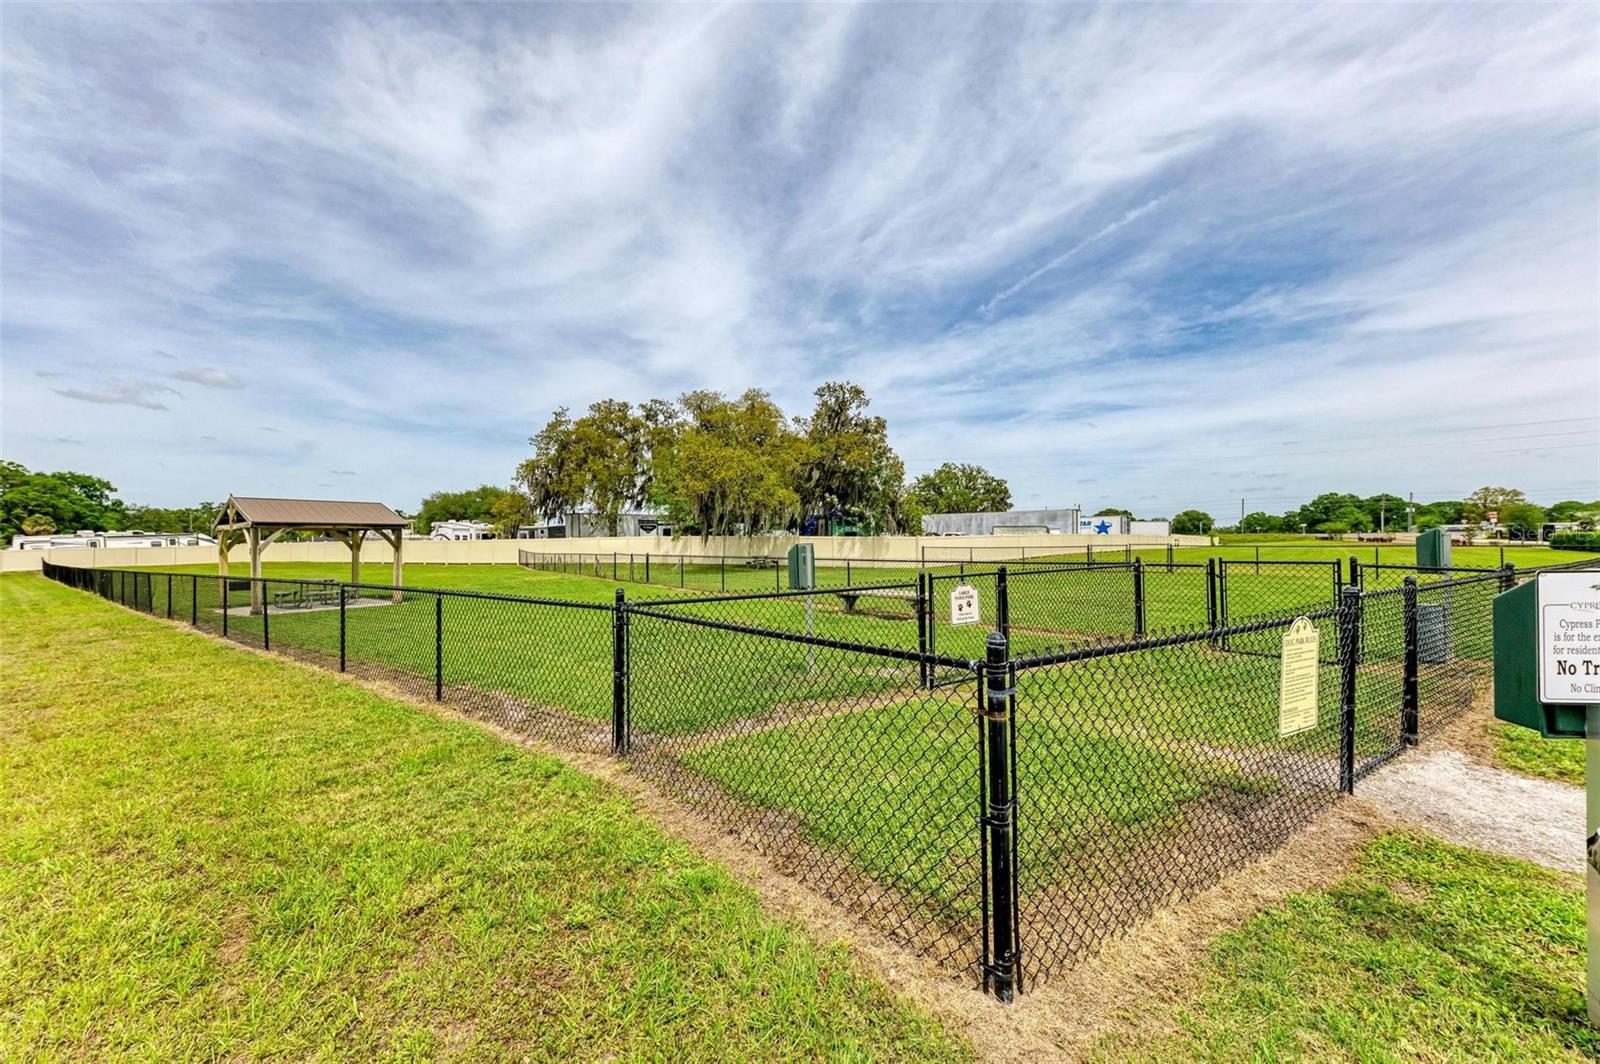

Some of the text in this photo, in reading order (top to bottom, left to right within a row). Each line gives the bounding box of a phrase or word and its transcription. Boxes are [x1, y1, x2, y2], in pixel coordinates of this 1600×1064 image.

[1559, 619, 1593, 631] Cypress
[1553, 632, 1561, 641] is
[1563, 632, 1575, 641] for
[1577, 632, 1591, 641] the
[1553, 644, 1565, 654] for
[1556, 660, 1600, 675] No Tr
[1570, 683, 1582, 693] No
